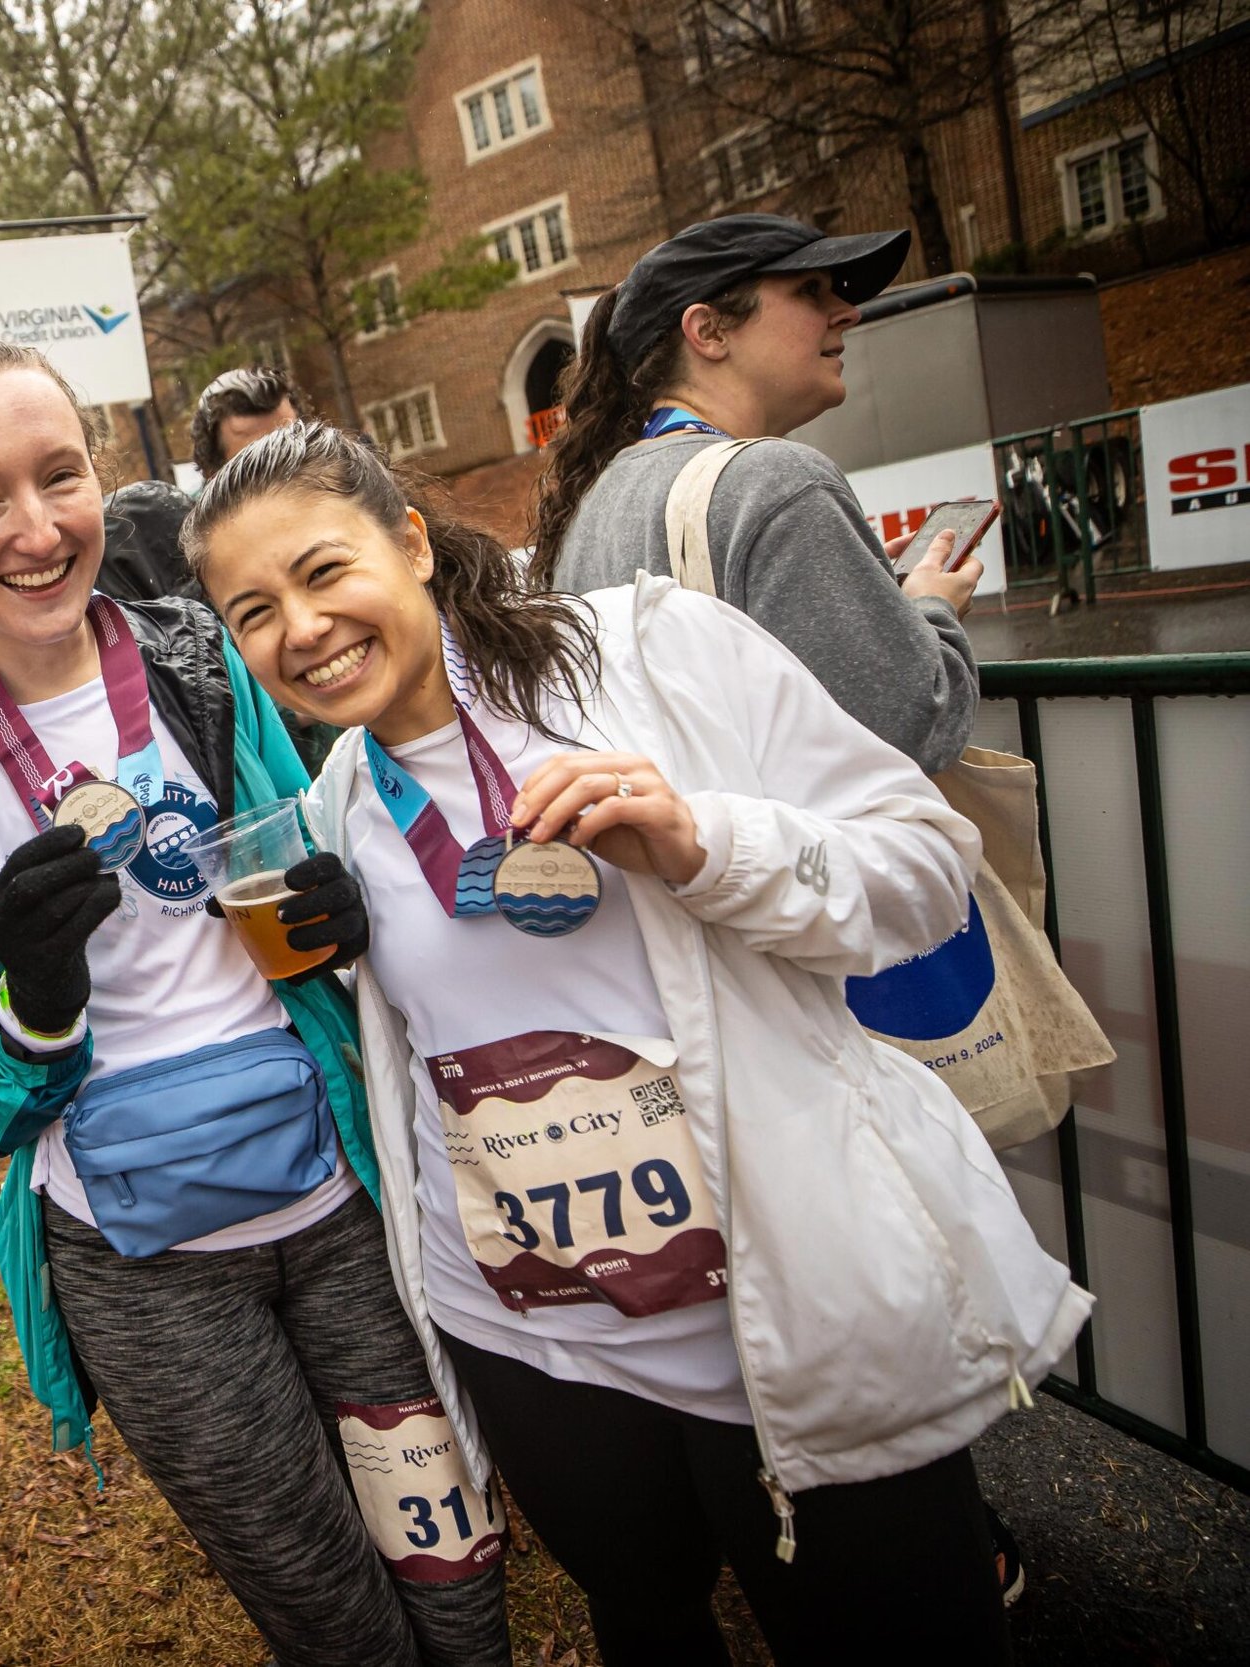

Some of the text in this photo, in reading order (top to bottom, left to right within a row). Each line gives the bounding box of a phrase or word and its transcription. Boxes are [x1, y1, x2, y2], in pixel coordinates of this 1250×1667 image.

[50, 325, 95, 341] Union
[161, 789, 192, 805] ITY
[157, 877, 195, 893] HALF
[960, 1049, 973, 1061] 9,
[975, 1031, 1005, 1054] 2024
[439, 1063, 465, 1079] 3779
[470, 1084, 496, 1095] MARCH
[504, 1078, 524, 1089] 2024
[529, 1064, 577, 1082] RICHMOND,
[576, 1059, 589, 1069] VA
[482, 1130, 538, 1159] River
[570, 1110, 622, 1136] City
[495, 1159, 692, 1250] 3779
[598, 1258, 630, 1273] SPORTS
[560, 1286, 591, 1297] CHECK
[398, 1404, 423, 1414] MARCH
[402, 1440, 451, 1468] River
